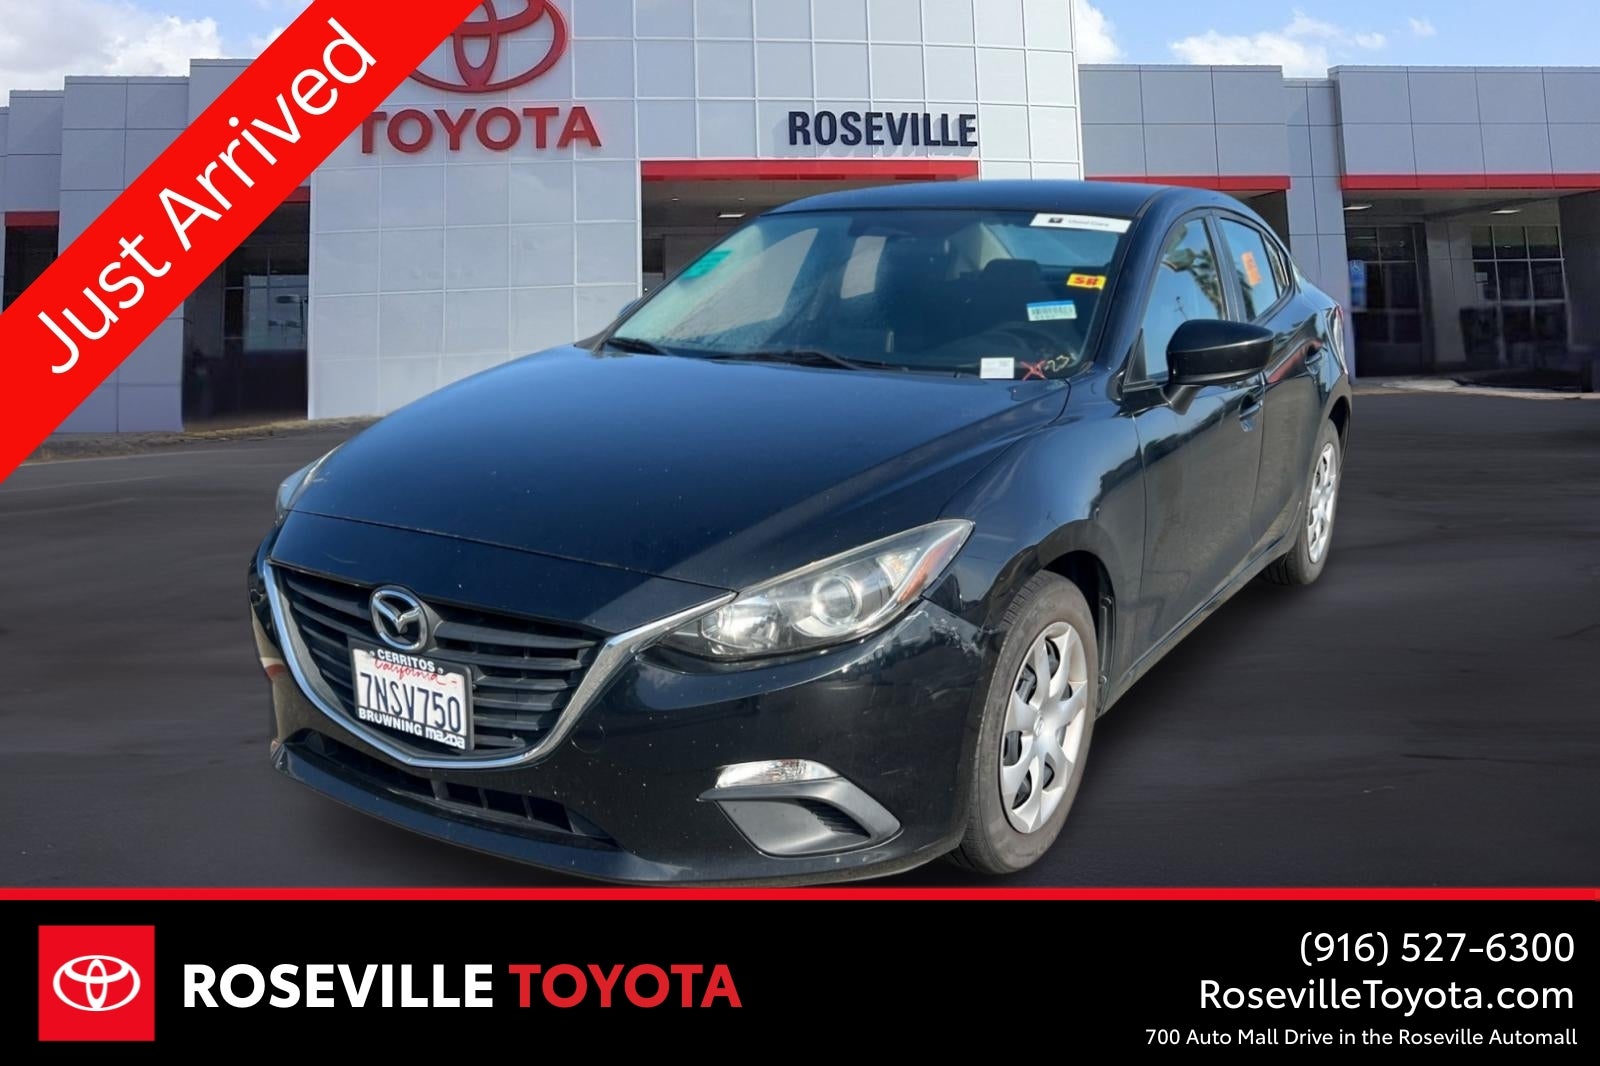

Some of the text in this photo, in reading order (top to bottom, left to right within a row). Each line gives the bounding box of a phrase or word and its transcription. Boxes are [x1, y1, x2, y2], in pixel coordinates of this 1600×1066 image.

[361, 106, 603, 154] TOYOTA
[788, 110, 978, 148] ROSEVILLE
[377, 649, 436, 673] CERRITOS
[360, 672, 462, 733] 7NSV750
[358, 707, 423, 737] BROWNING
